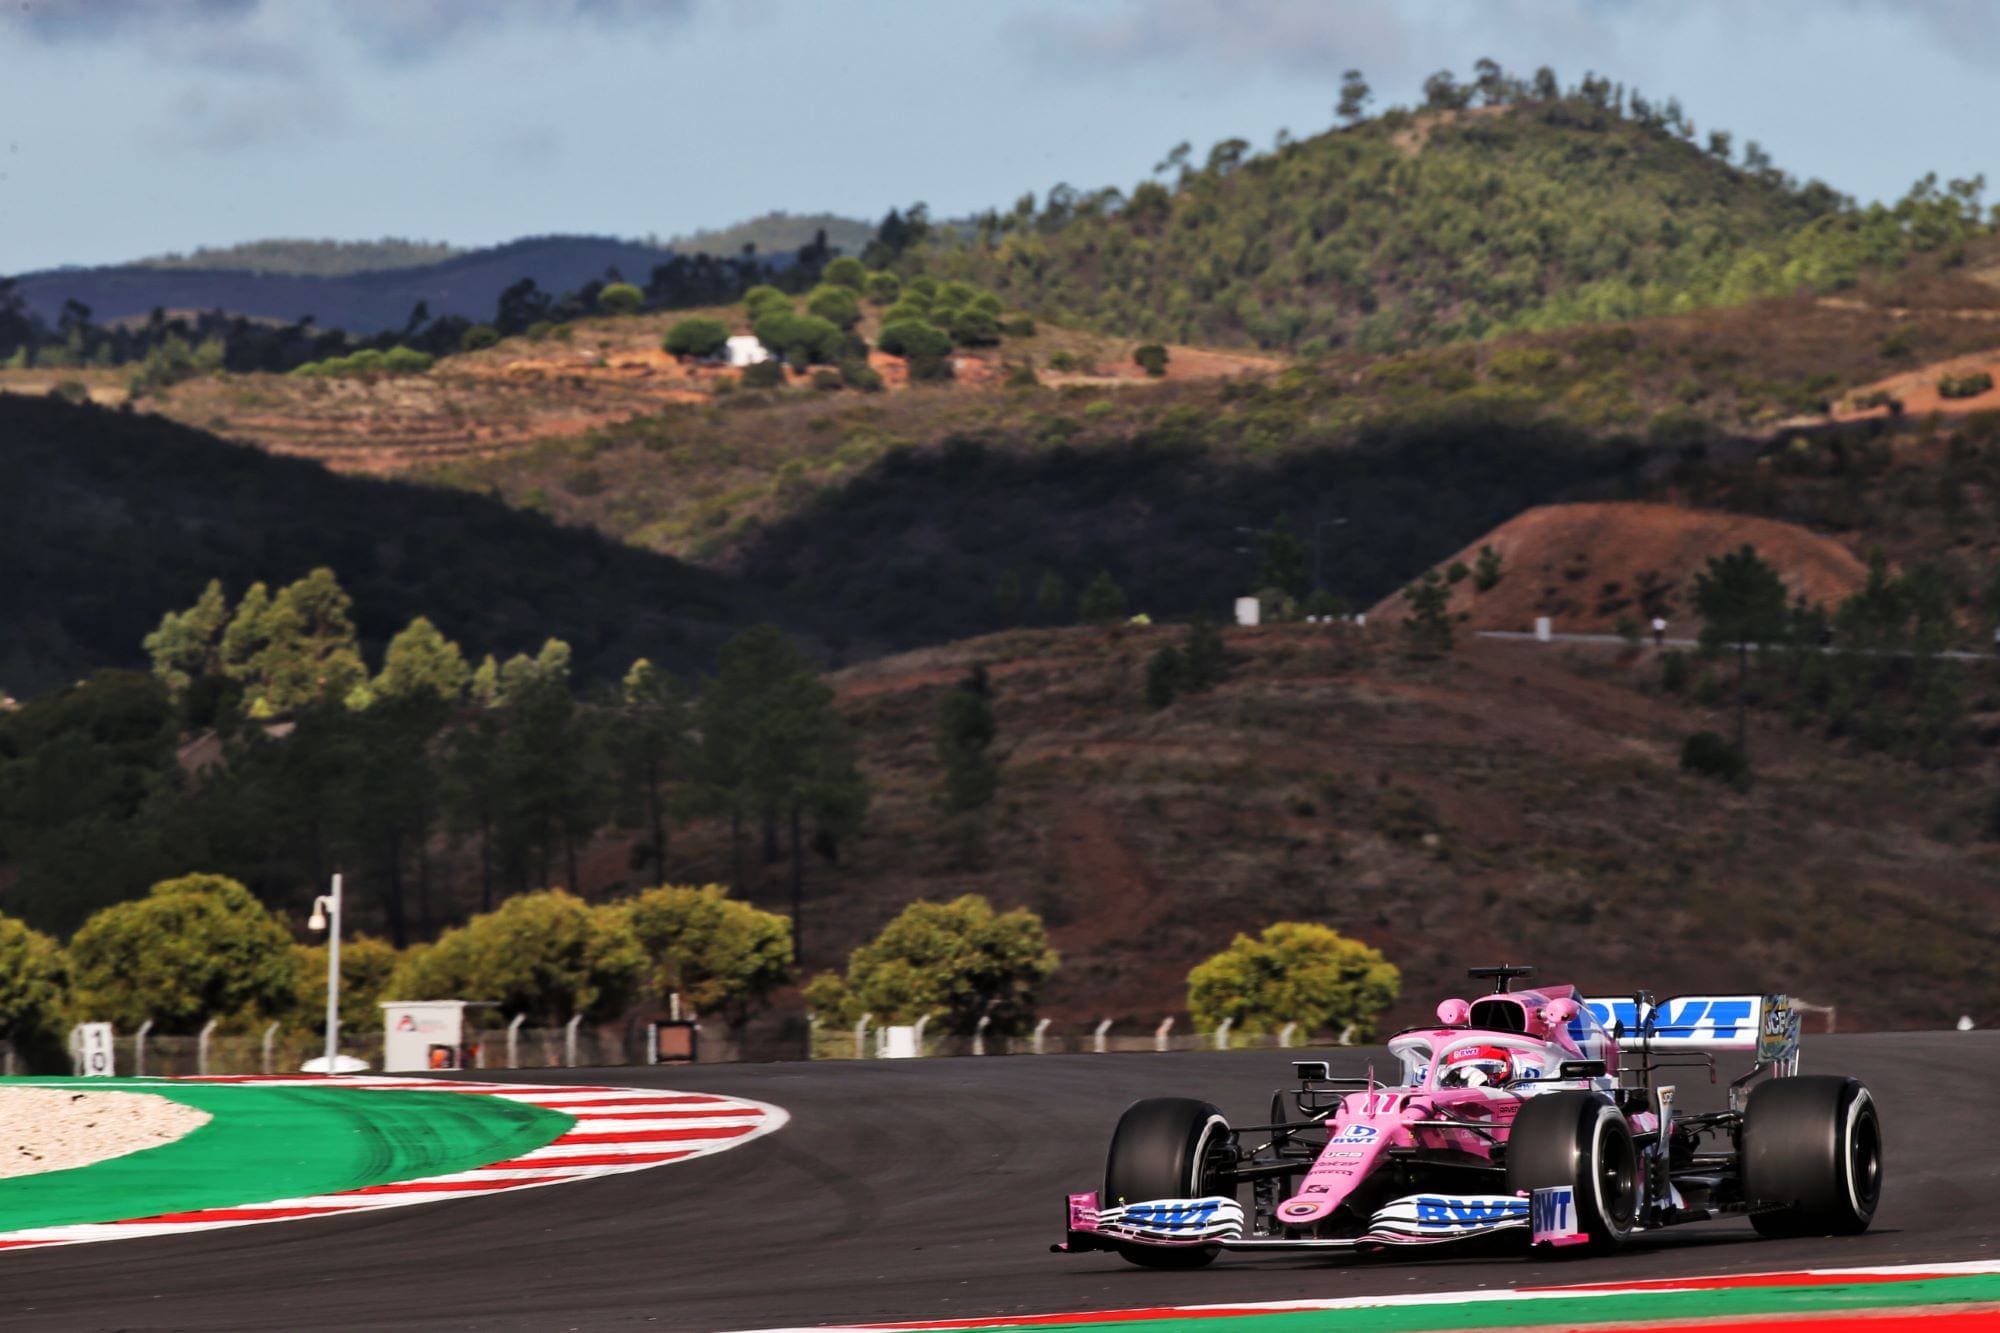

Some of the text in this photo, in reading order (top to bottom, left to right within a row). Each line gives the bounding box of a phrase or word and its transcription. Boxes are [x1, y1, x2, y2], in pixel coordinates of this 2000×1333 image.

[1361, 1094, 1399, 1113] 11
[1120, 1200, 1221, 1231] BWT
[1534, 1191, 1571, 1232] BWT
